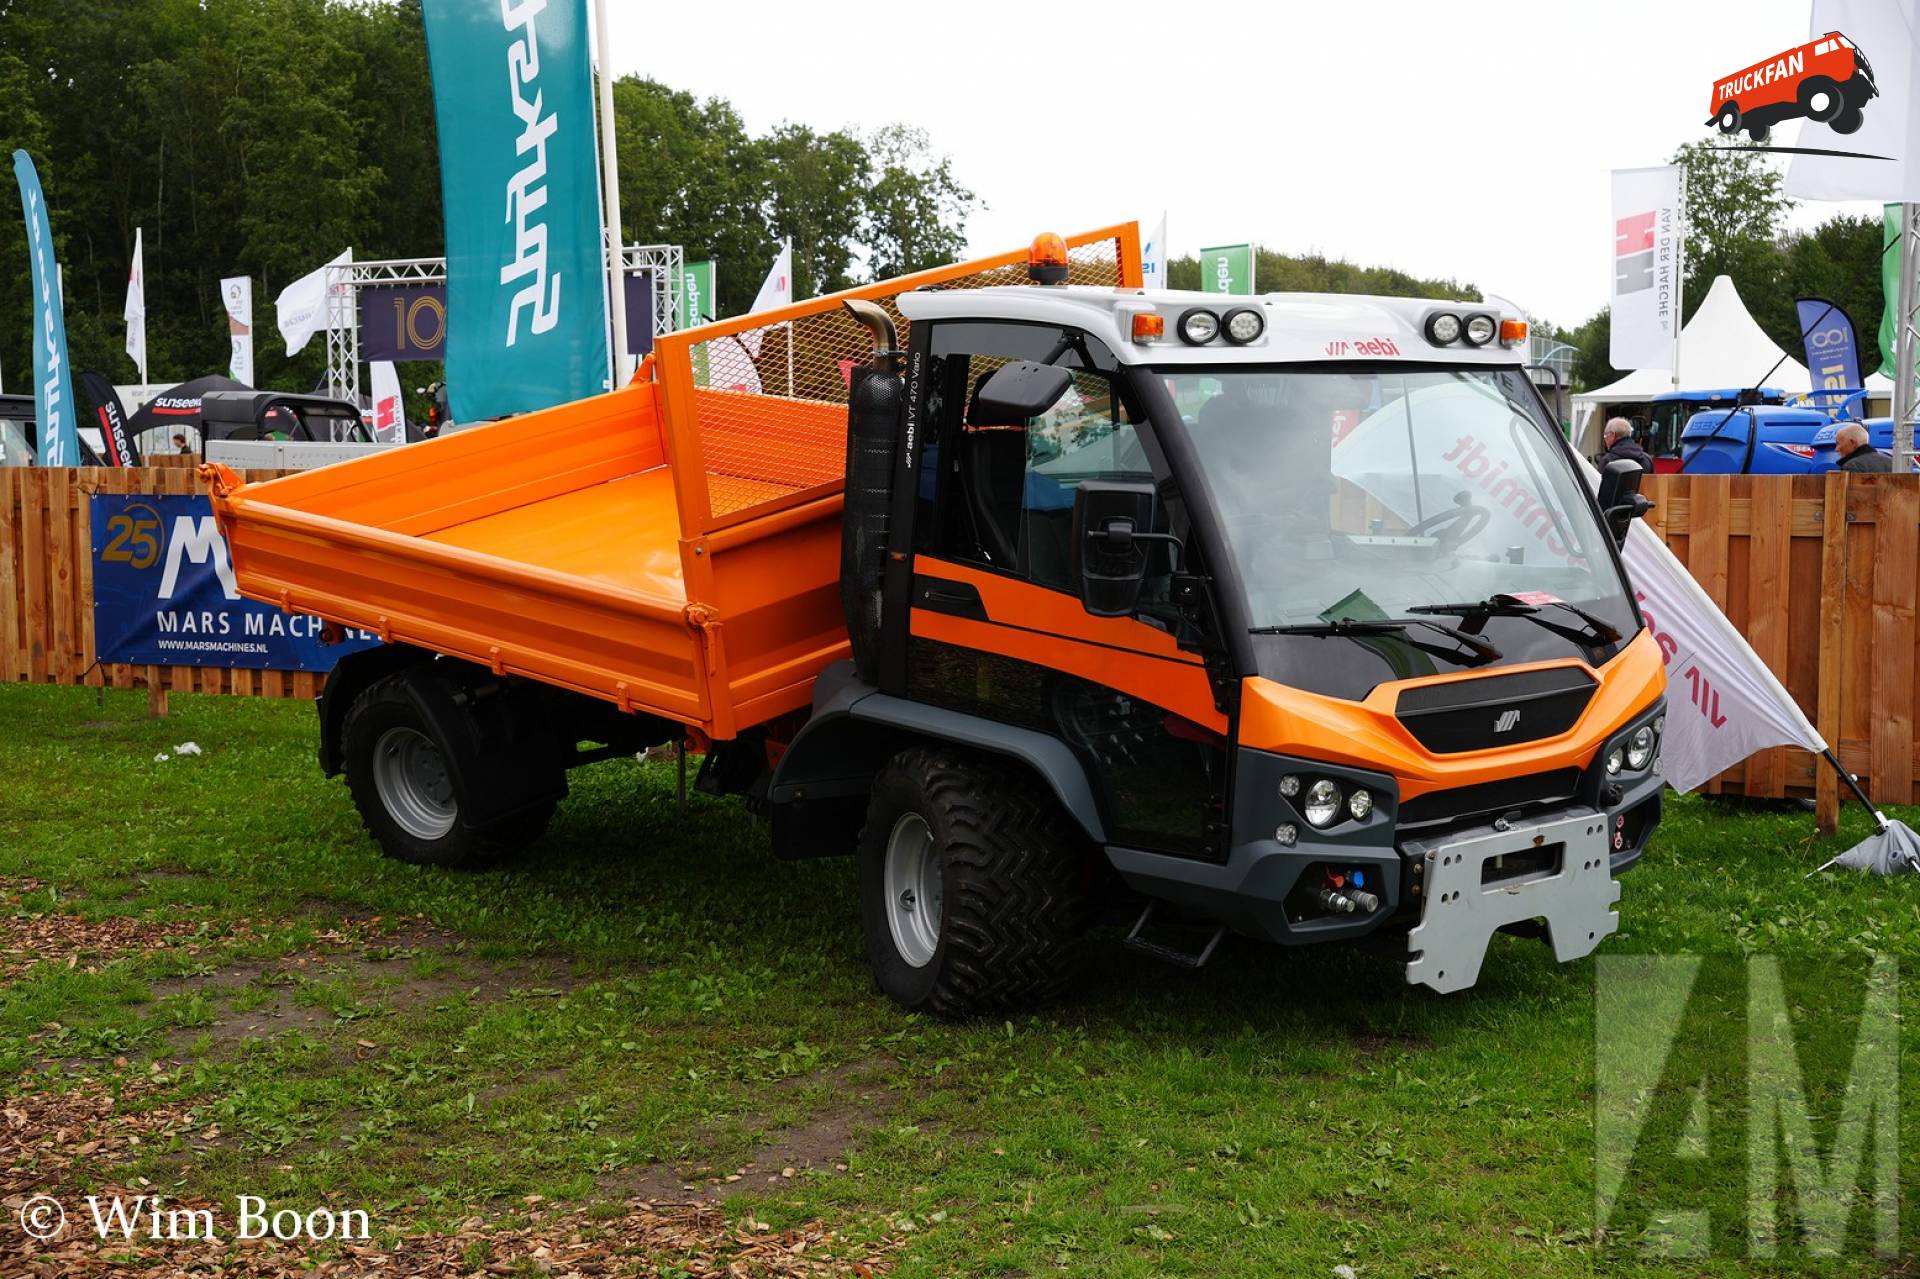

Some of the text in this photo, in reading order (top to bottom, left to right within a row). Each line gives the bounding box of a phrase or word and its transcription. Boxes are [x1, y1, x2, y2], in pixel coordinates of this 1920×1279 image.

[1354, 337, 1401, 356] aebi
[101, 515, 158, 570] 25
[156, 611, 230, 635] MARS
[158, 640, 269, 653] WWW.MARSMACHINES.NL
